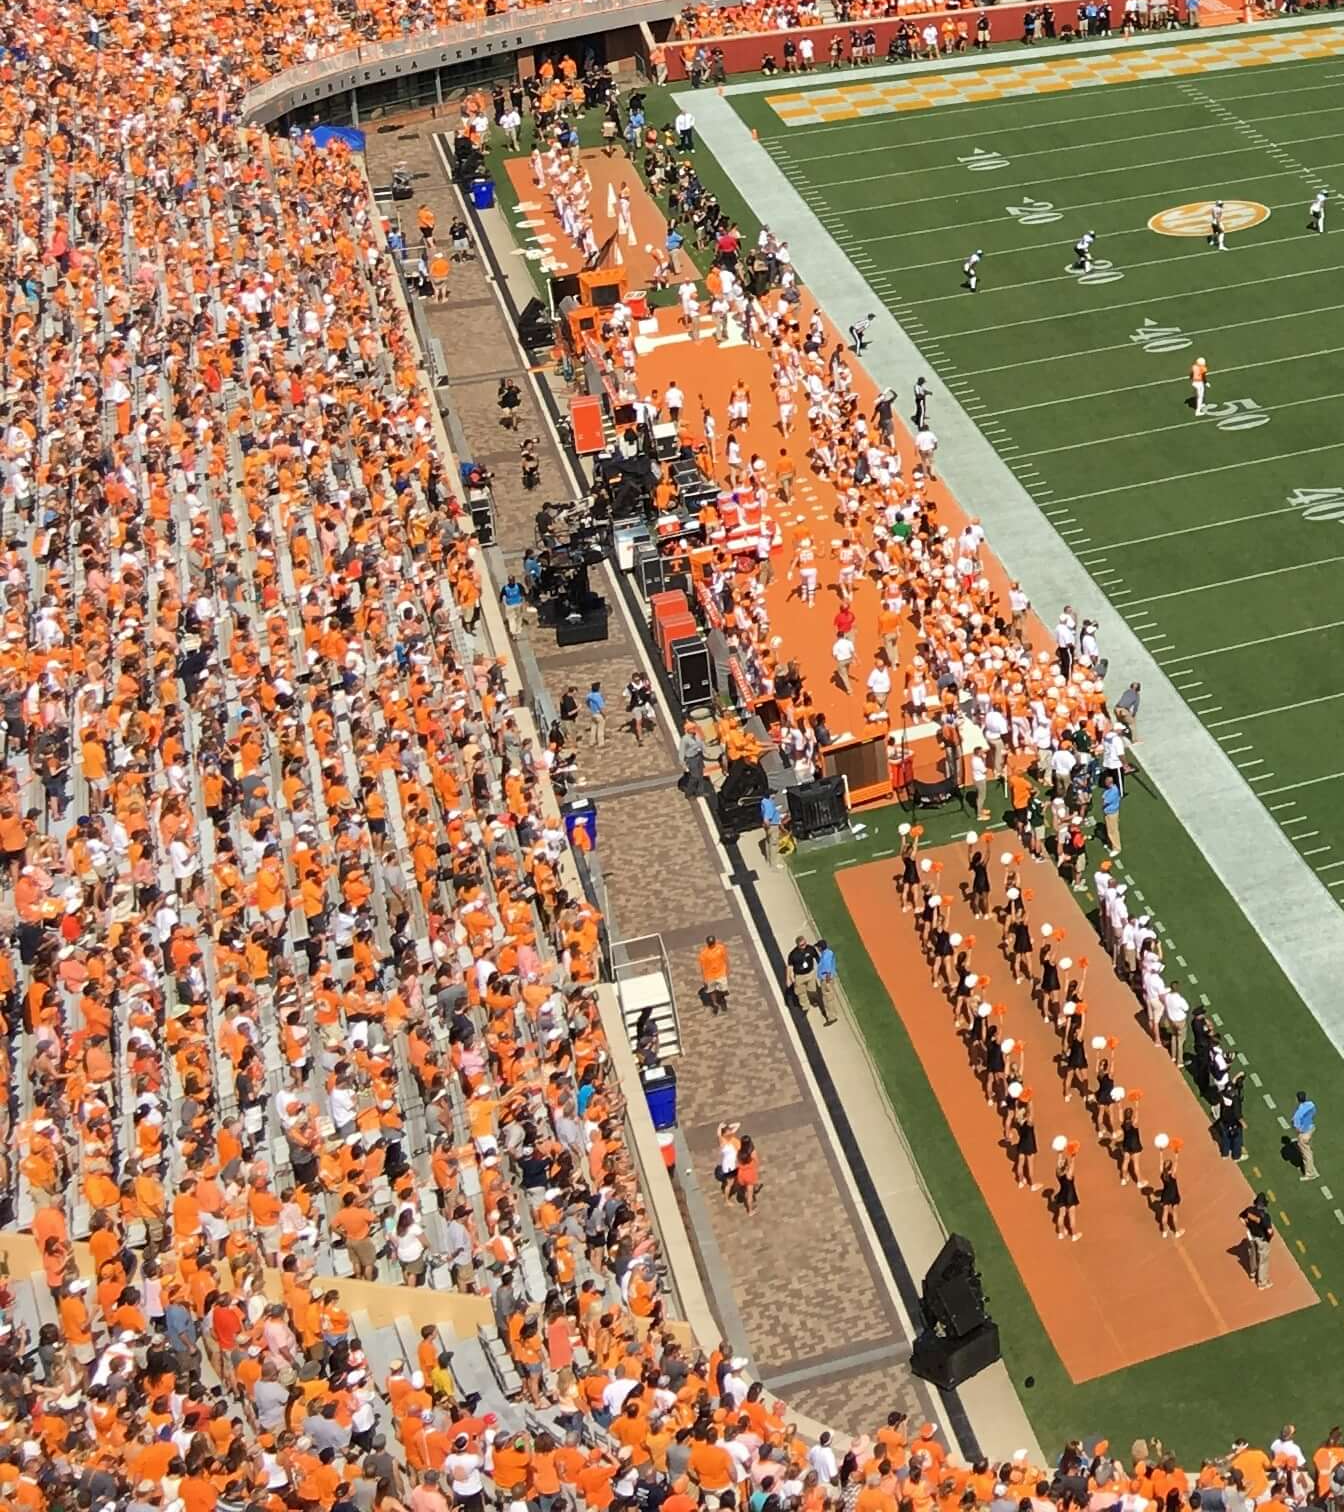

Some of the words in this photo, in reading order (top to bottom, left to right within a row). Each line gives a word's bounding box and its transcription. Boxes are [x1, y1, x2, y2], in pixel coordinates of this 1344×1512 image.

[440, 36, 523, 62] CENTER
[1005, 201, 1064, 224] 20
[1129, 326, 1194, 353] 40
[1200, 397, 1272, 432] 50
